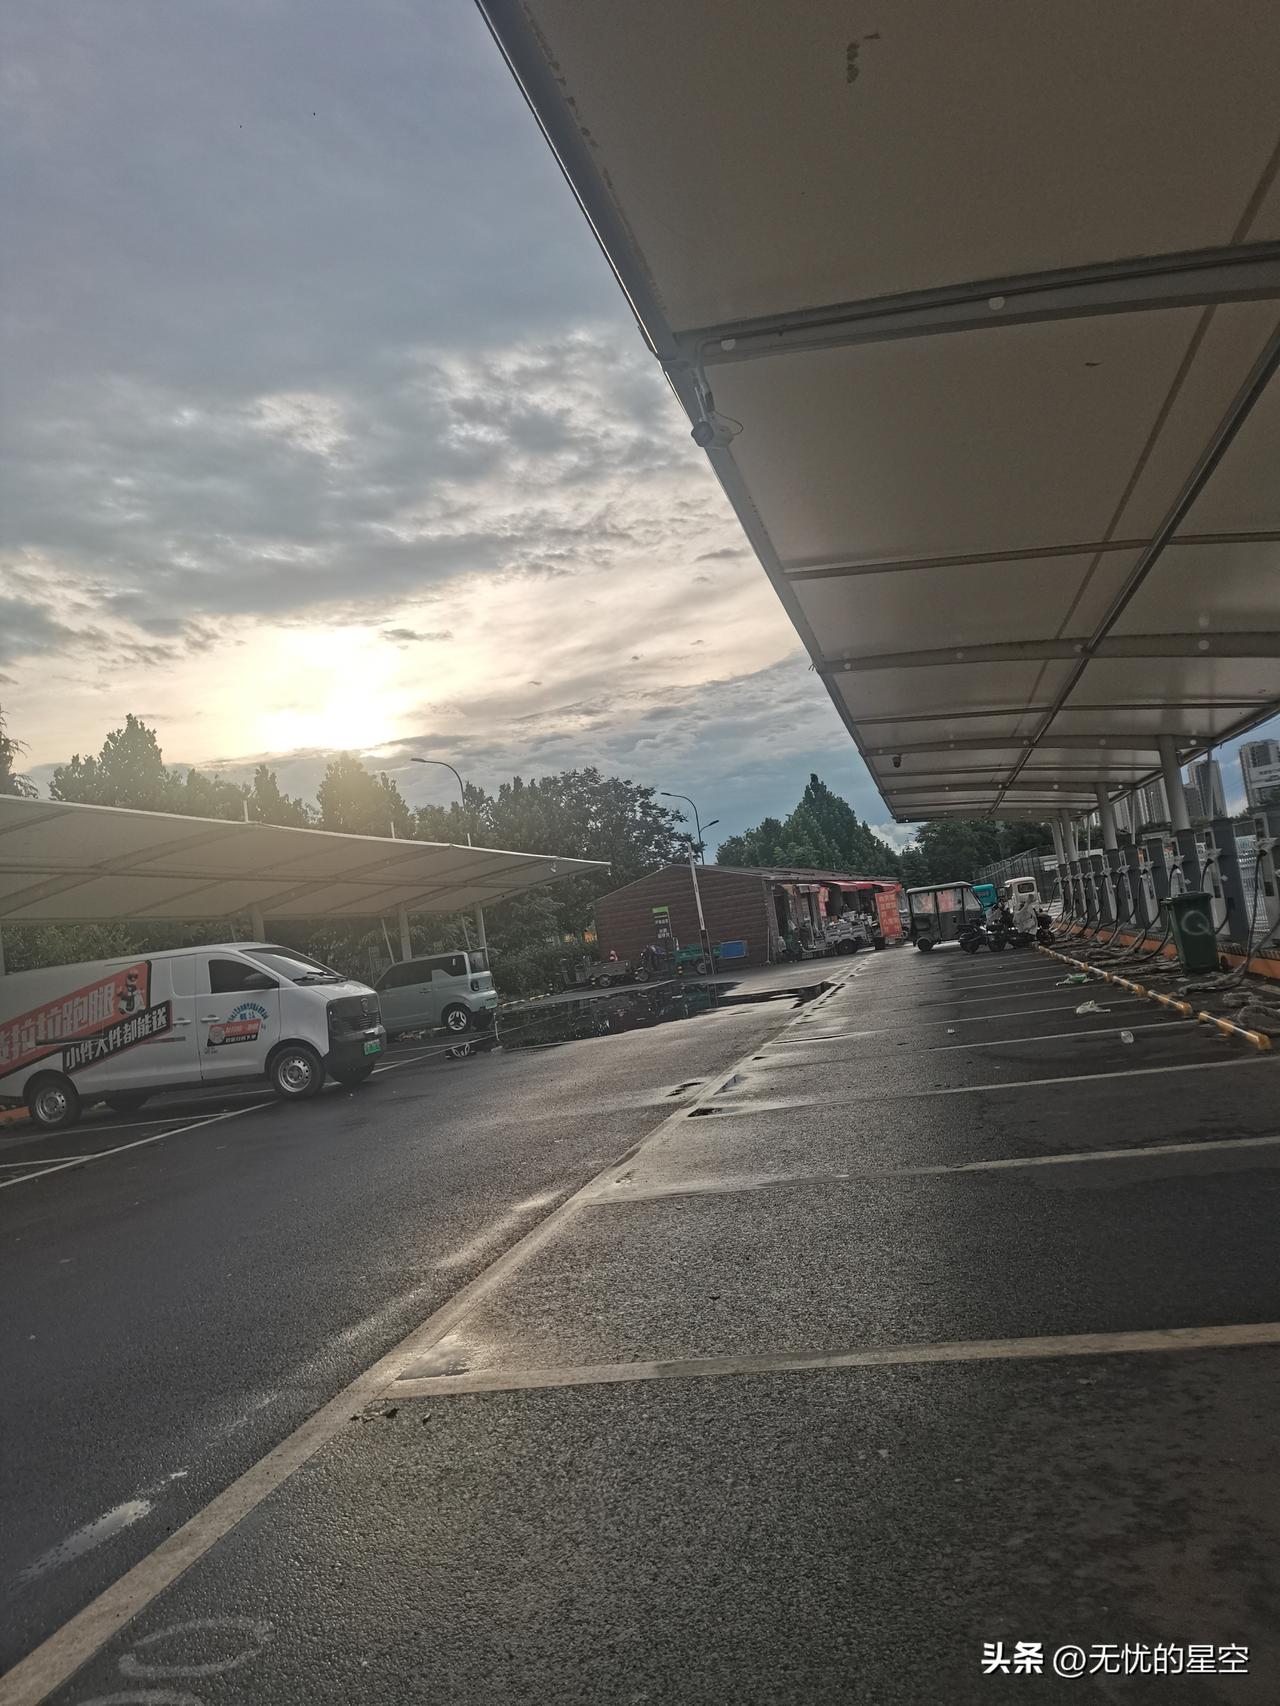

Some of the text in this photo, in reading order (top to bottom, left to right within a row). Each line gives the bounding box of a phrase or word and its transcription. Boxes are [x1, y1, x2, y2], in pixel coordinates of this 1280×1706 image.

[65, 1006, 169, 1070] 小件大件都能送
